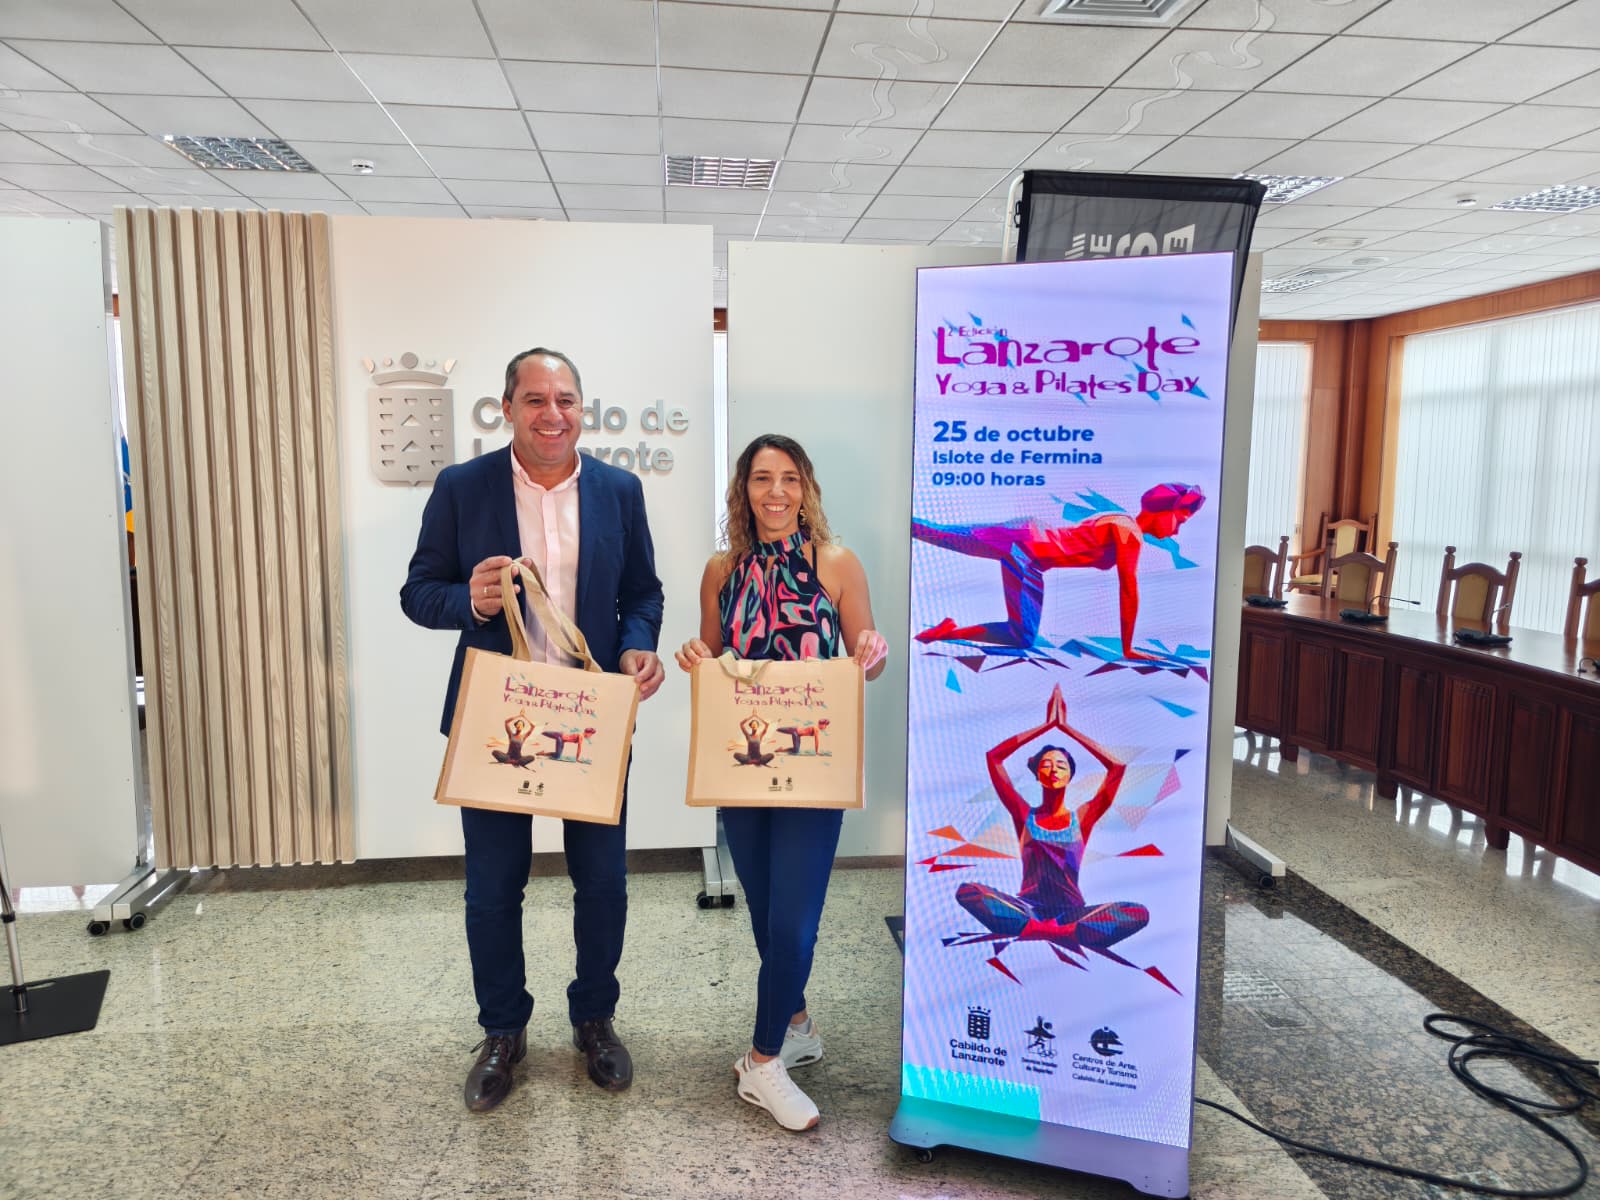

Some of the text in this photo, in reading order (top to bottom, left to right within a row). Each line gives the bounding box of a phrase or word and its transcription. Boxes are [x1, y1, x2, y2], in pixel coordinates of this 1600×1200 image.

[936, 326, 1201, 371] Lanzarote
[935, 369, 1201, 400] Yoga & Pilates Day
[640, 399, 689, 433] de
[933, 420, 1095, 442] 25 de octubre
[932, 449, 1103, 464] Islote de Fermina
[932, 472, 1046, 486] 09:00 horas
[504, 676, 598, 707] Lanzarote
[735, 680, 825, 698] Lanzarote
[949, 1038, 1008, 1057] Cabildo de
[951, 1049, 1006, 1067] Lanzarote
[1072, 1052, 1104, 1065] Centros
[1105, 1059, 1117, 1067] de
